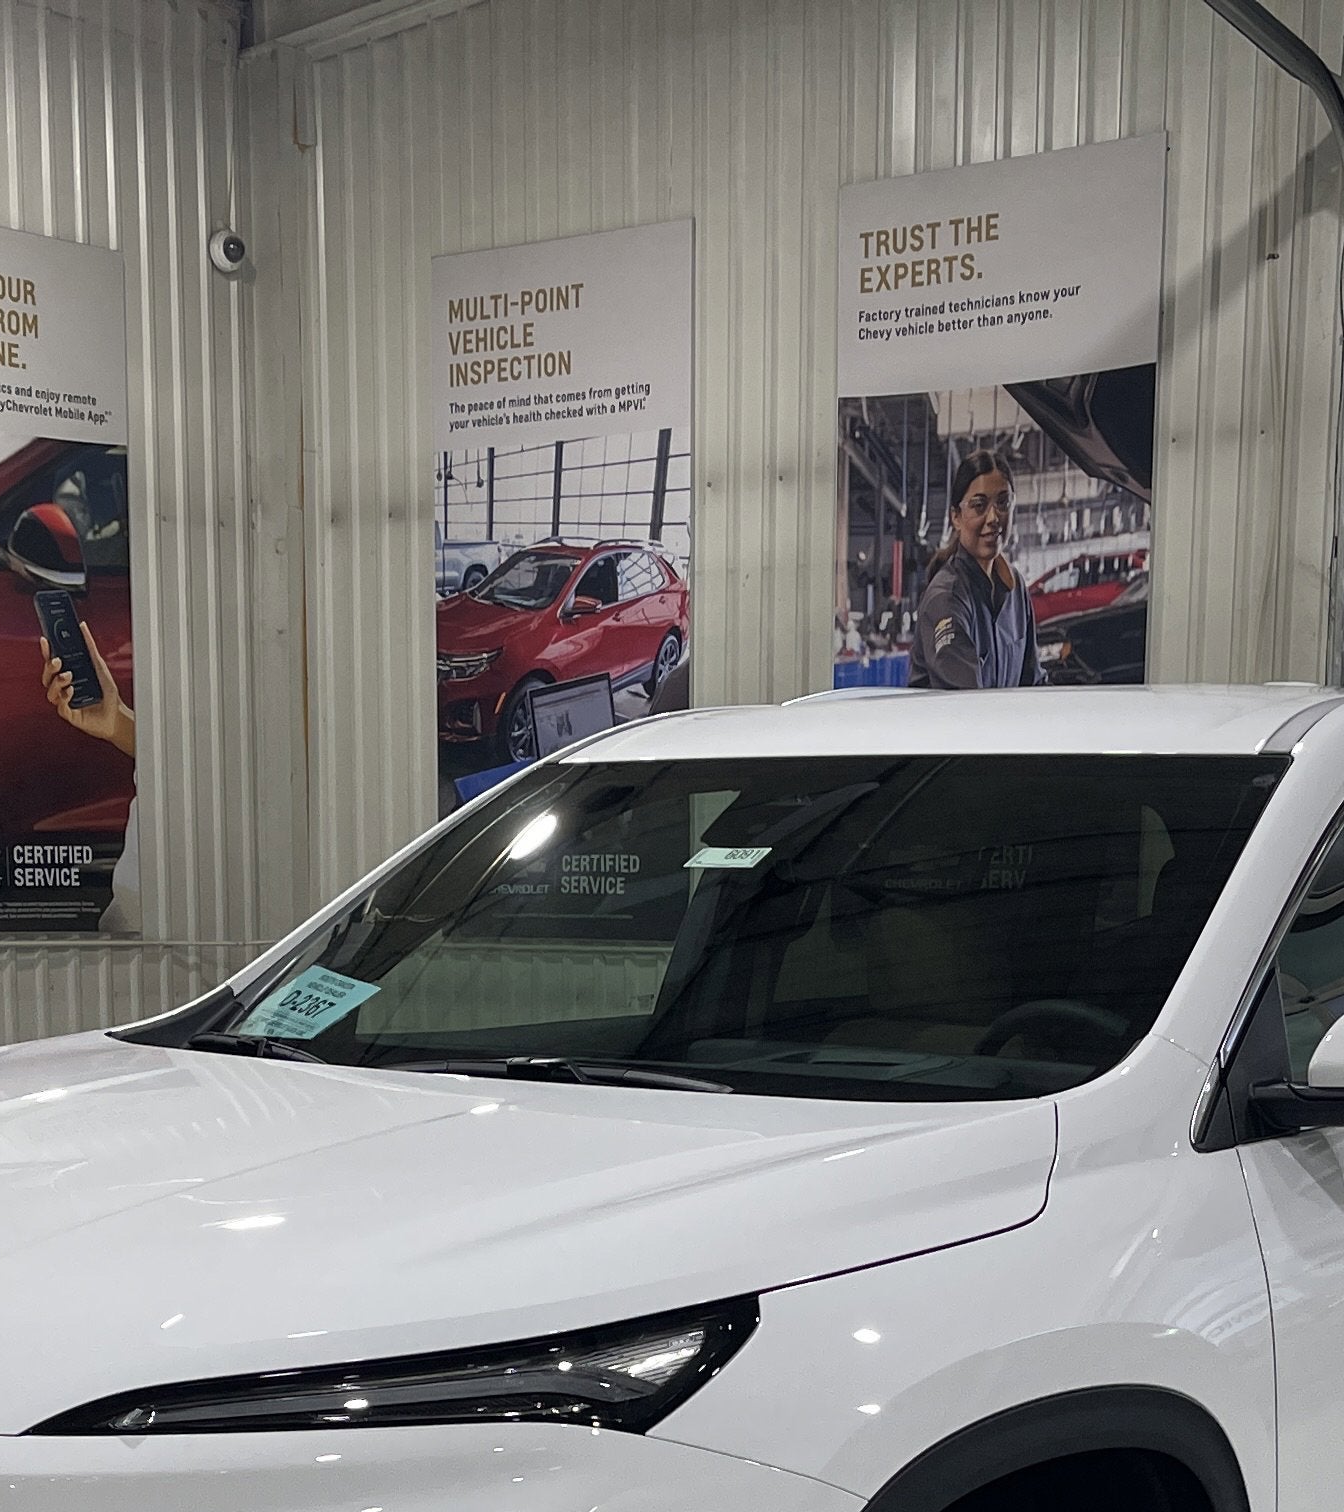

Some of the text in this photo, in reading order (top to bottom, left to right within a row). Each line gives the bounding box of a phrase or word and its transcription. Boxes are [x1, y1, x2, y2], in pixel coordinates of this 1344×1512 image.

[860, 212, 1000, 259] TRUST THE
[860, 253, 984, 294] EXPERTS.
[448, 283, 584, 324] MULTI-POINT
[858, 285, 1082, 324] Factory trained technicians know your
[448, 322, 535, 355] VEHICLE
[858, 309, 1053, 342] Chevy vehicle better than anyone.
[449, 350, 572, 388] INSPECTION
[14, 383, 33, 399] and
[35, 387, 61, 405] enjoy
[63, 392, 97, 407] remote
[449, 382, 651, 416] The peace of mind that comes from getting
[55, 406, 85, 421] Mobile
[449, 418, 469, 432] your
[472, 413, 511, 428] vehicle's
[513, 409, 542, 424] health
[544, 405, 584, 421] checked
[586, 402, 608, 417] with
[609, 404, 616, 413] a
[13, 845, 93, 864] CERTIFIED
[562, 854, 640, 873] CERTIFIED
[14, 868, 81, 887] SERVICE
[561, 876, 625, 894] SERVICE
